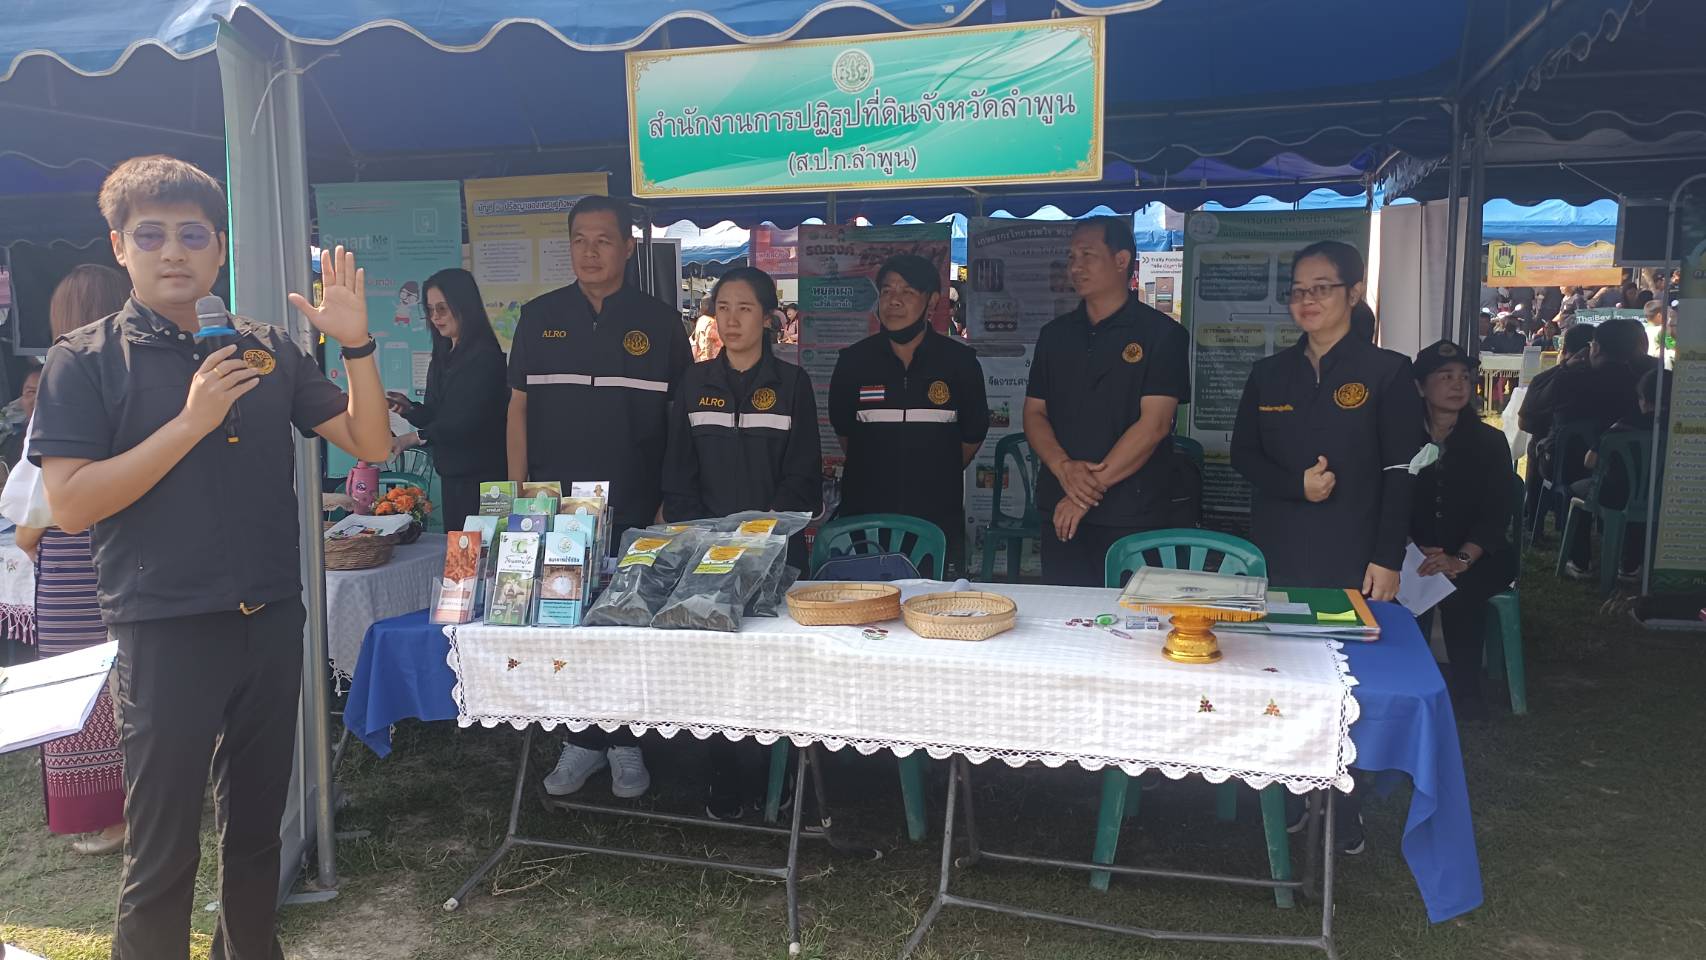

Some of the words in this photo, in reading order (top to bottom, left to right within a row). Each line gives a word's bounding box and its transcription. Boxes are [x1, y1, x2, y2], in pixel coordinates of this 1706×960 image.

[648, 88, 1077, 138] สำนักงานการปฏิรูปที่ดินจังหวัดลำพูน
[787, 147, 919, 177] (ส.ป.ก.ลำพูน)
[372, 234, 389, 246] Me
[542, 329, 567, 338] ALRO
[698, 396, 726, 408] ALRO
